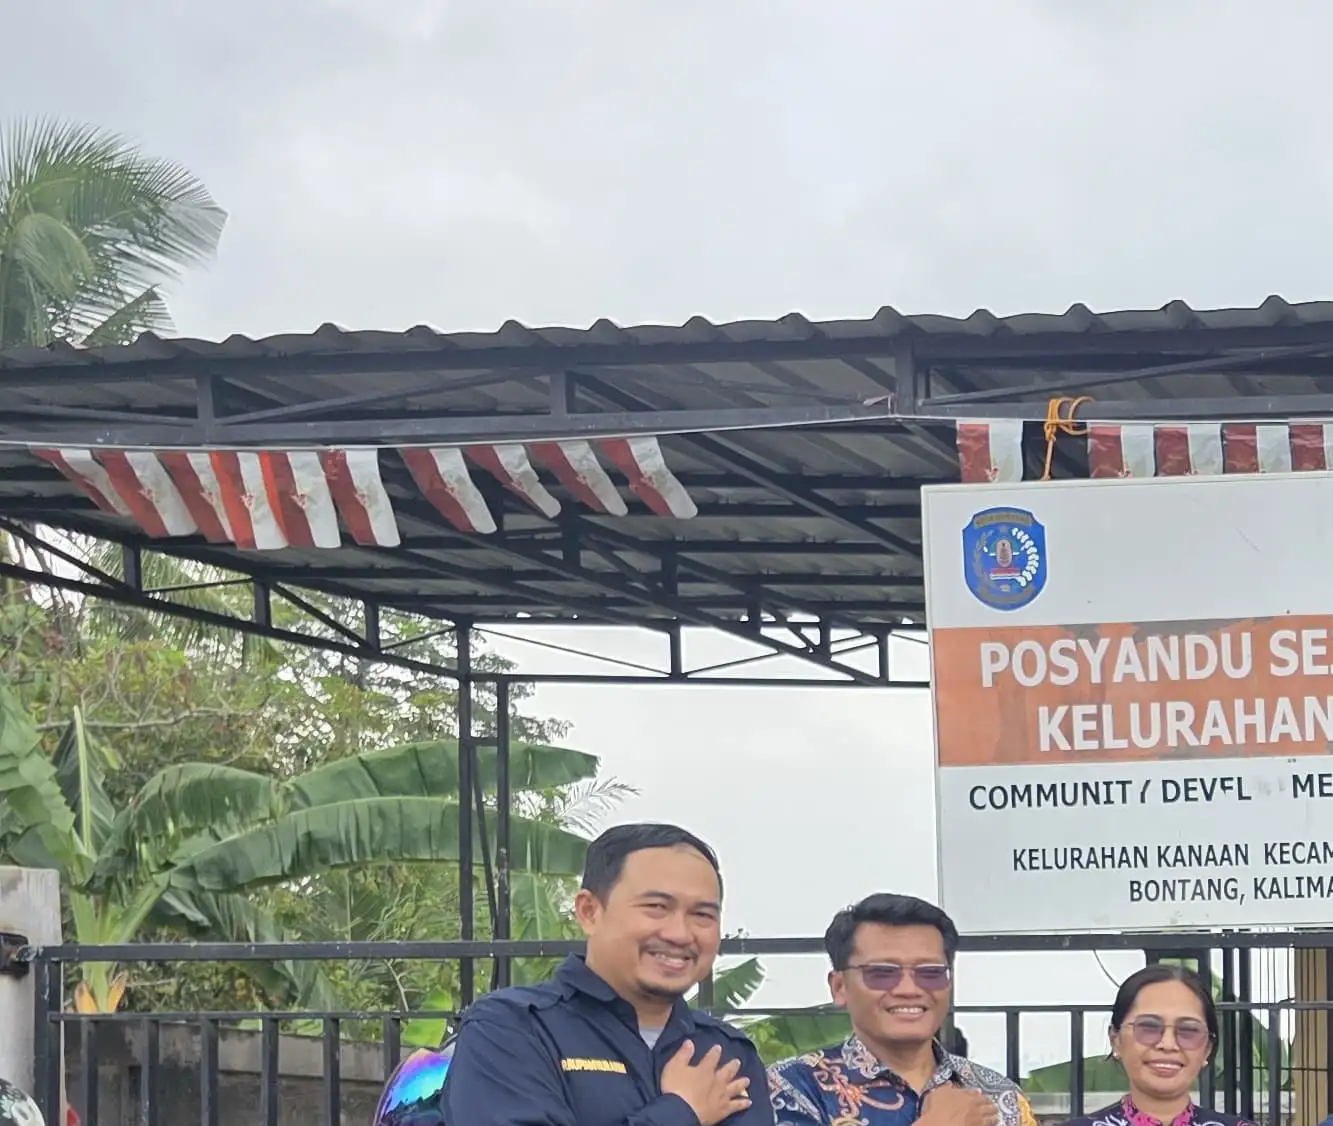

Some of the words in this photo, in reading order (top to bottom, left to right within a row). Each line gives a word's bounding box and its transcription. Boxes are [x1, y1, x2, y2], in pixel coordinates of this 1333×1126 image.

[980, 632, 1252, 688] POSYANDU
[1013, 846, 1149, 872] KELURAHAN
[1157, 843, 1249, 869] KANAAN
[1130, 877, 1245, 905] BONTANG,
